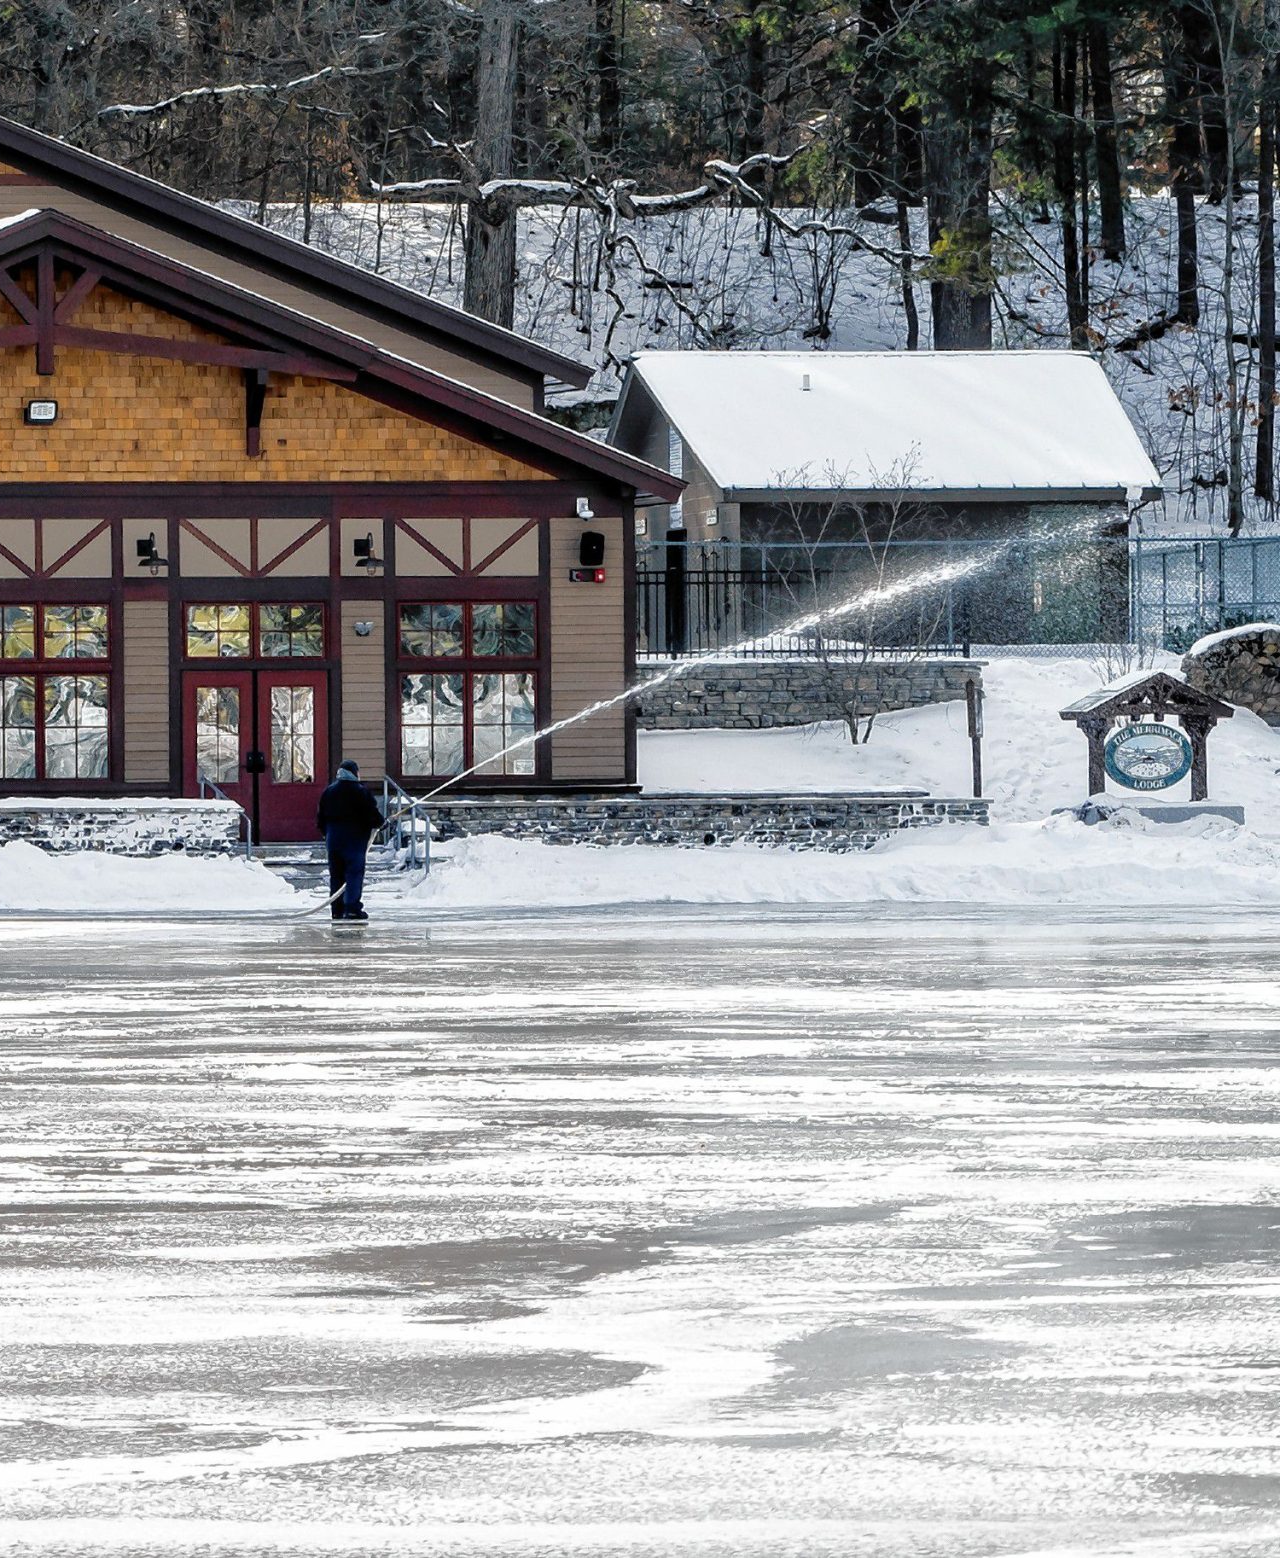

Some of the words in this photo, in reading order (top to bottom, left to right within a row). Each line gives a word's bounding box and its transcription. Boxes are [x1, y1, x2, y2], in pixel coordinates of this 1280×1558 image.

[1113, 729, 1131, 745] THE
[1132, 725, 1183, 746] MERRIMACK
[1134, 779, 1166, 789] LODGE
